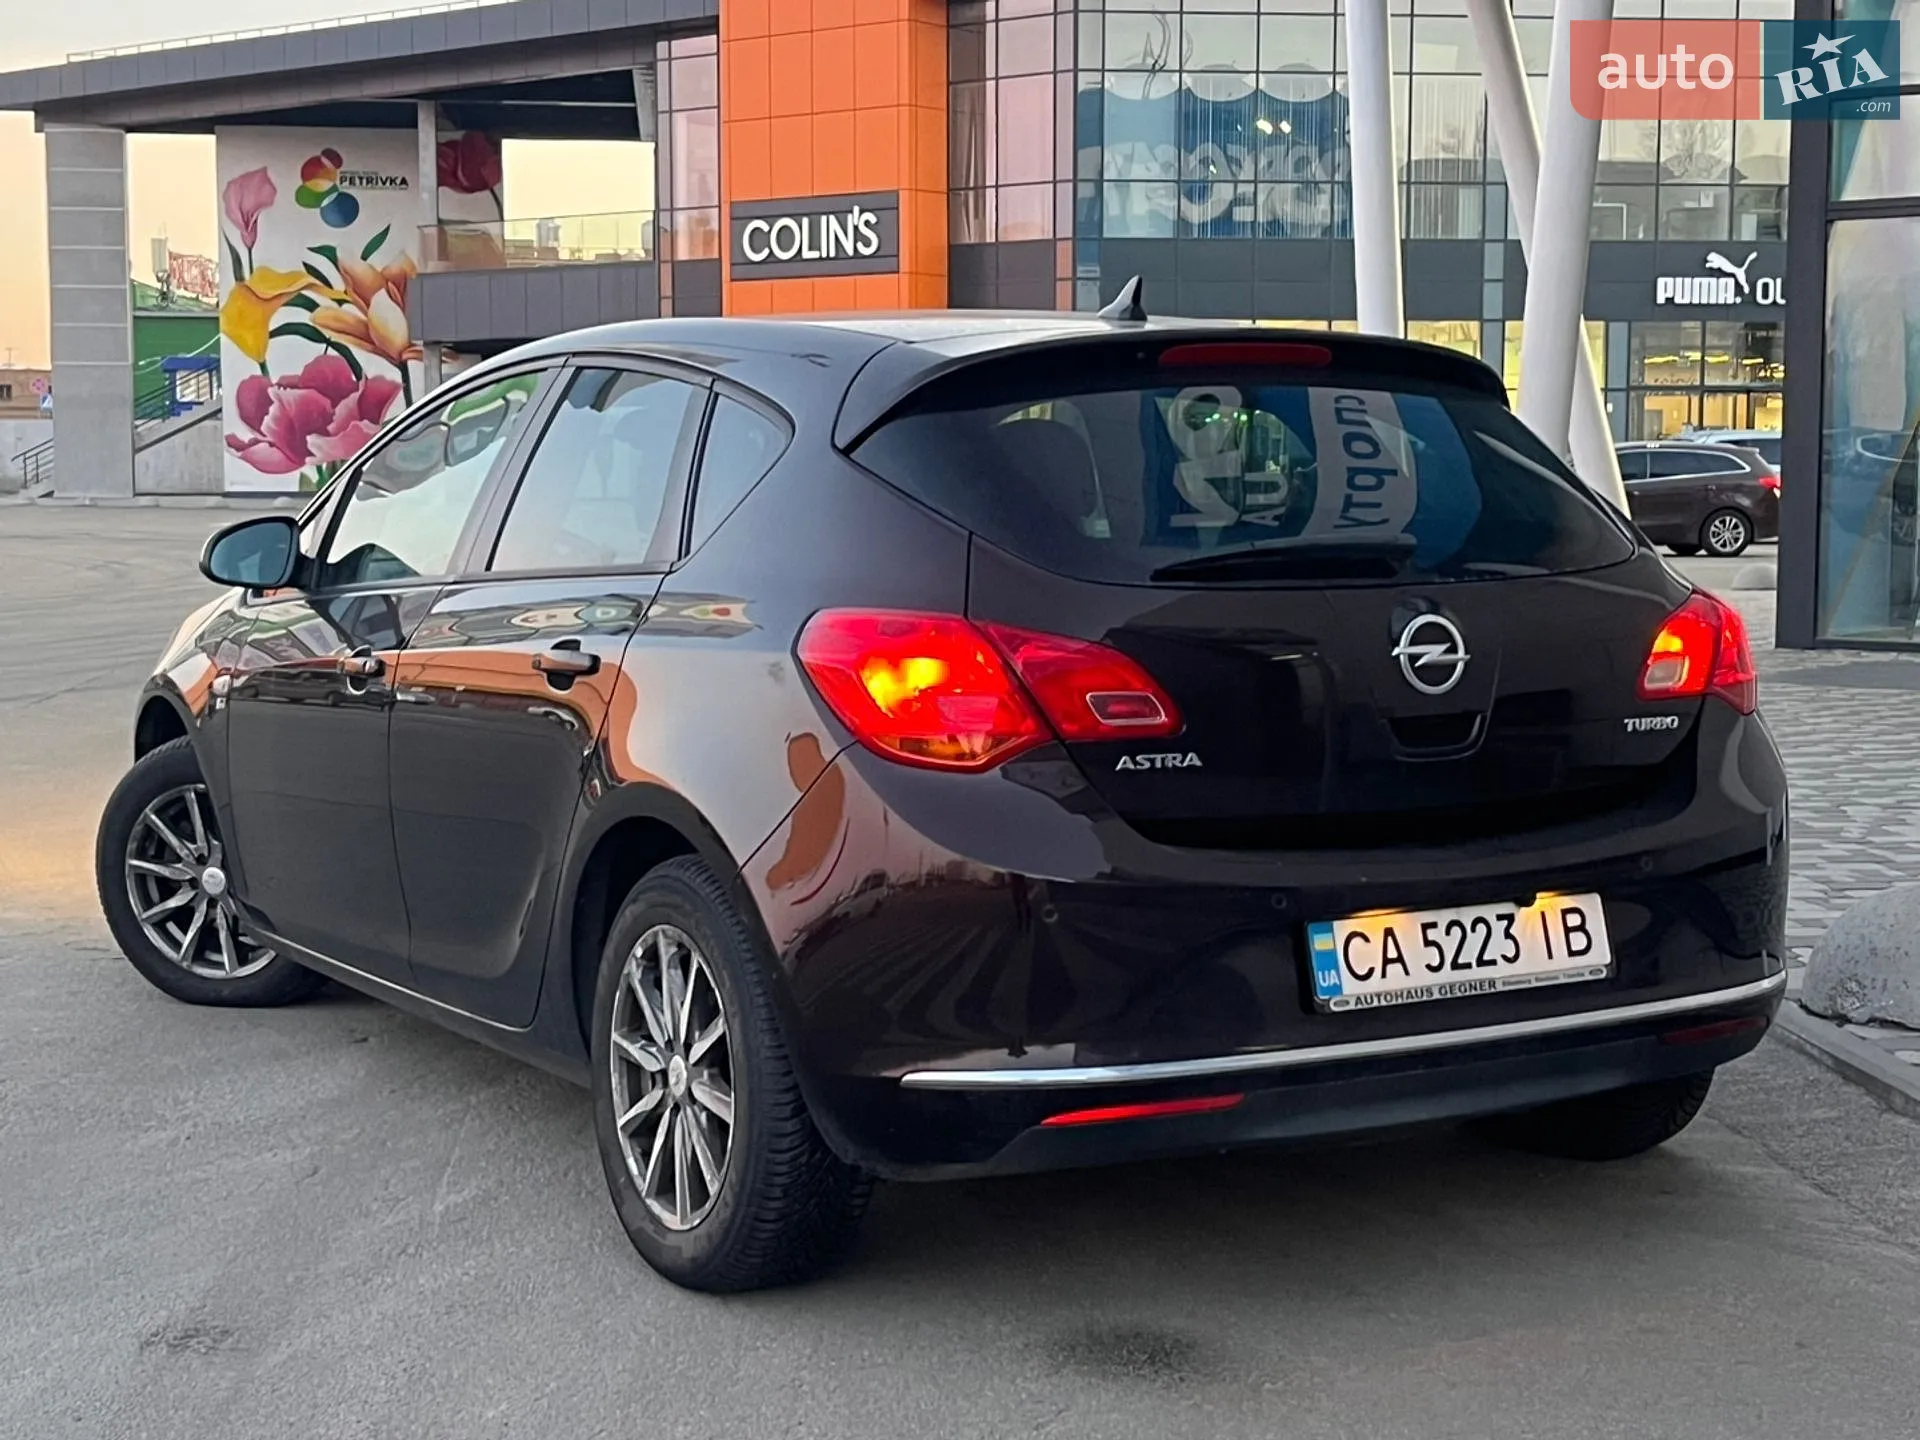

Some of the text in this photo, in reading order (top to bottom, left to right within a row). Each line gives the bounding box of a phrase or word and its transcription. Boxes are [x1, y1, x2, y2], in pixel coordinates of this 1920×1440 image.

[743, 205, 879, 262] COLIN'S
[1656, 276, 1736, 305] PUMA
[1624, 716, 1678, 732] TURBO
[1115, 752, 1203, 772] ASTRA
[1343, 907, 1593, 982] CA 5223 IB
[1318, 970, 1340, 987] UA
[1354, 987, 1433, 1008] AUTOHAUS
